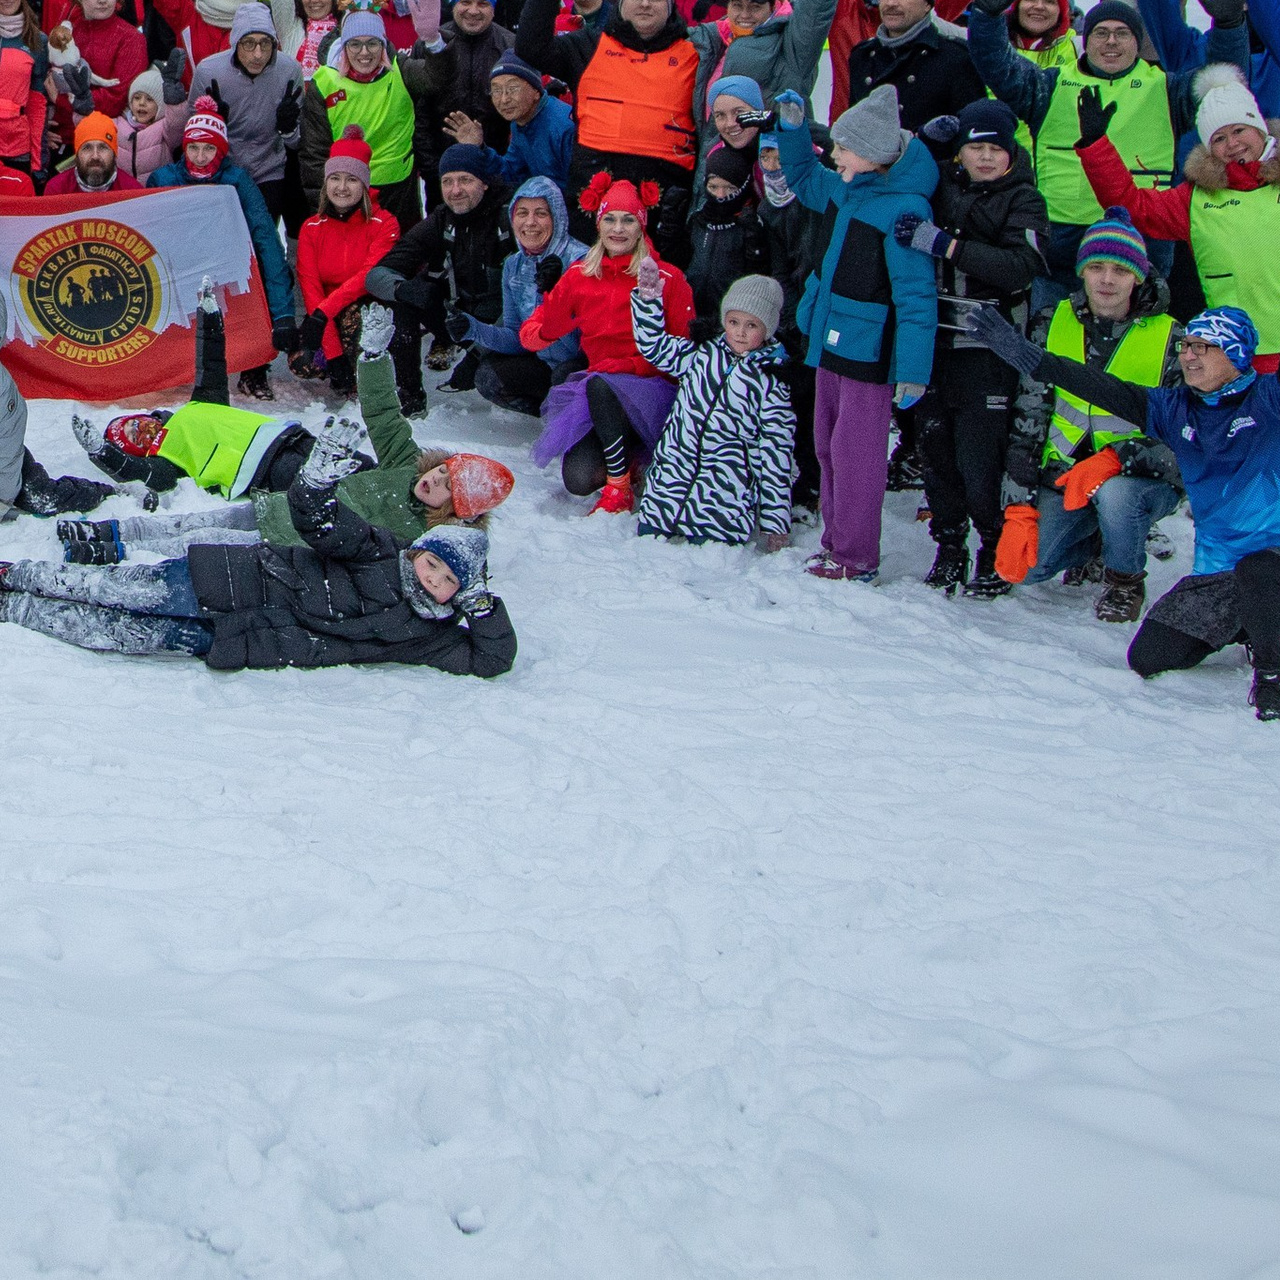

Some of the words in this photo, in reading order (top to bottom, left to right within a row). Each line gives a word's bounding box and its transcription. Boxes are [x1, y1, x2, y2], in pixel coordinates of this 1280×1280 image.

[186, 117, 226, 134] АРТАК
[1203, 198, 1241, 210] Вотёр
[18, 225, 78, 273] SPARTAK
[82, 222, 151, 261] MOSCOW
[39, 249, 77, 289] СКВАД
[110, 295, 143, 338] SQUAD
[55, 330, 151, 363] SUPPORTERS
